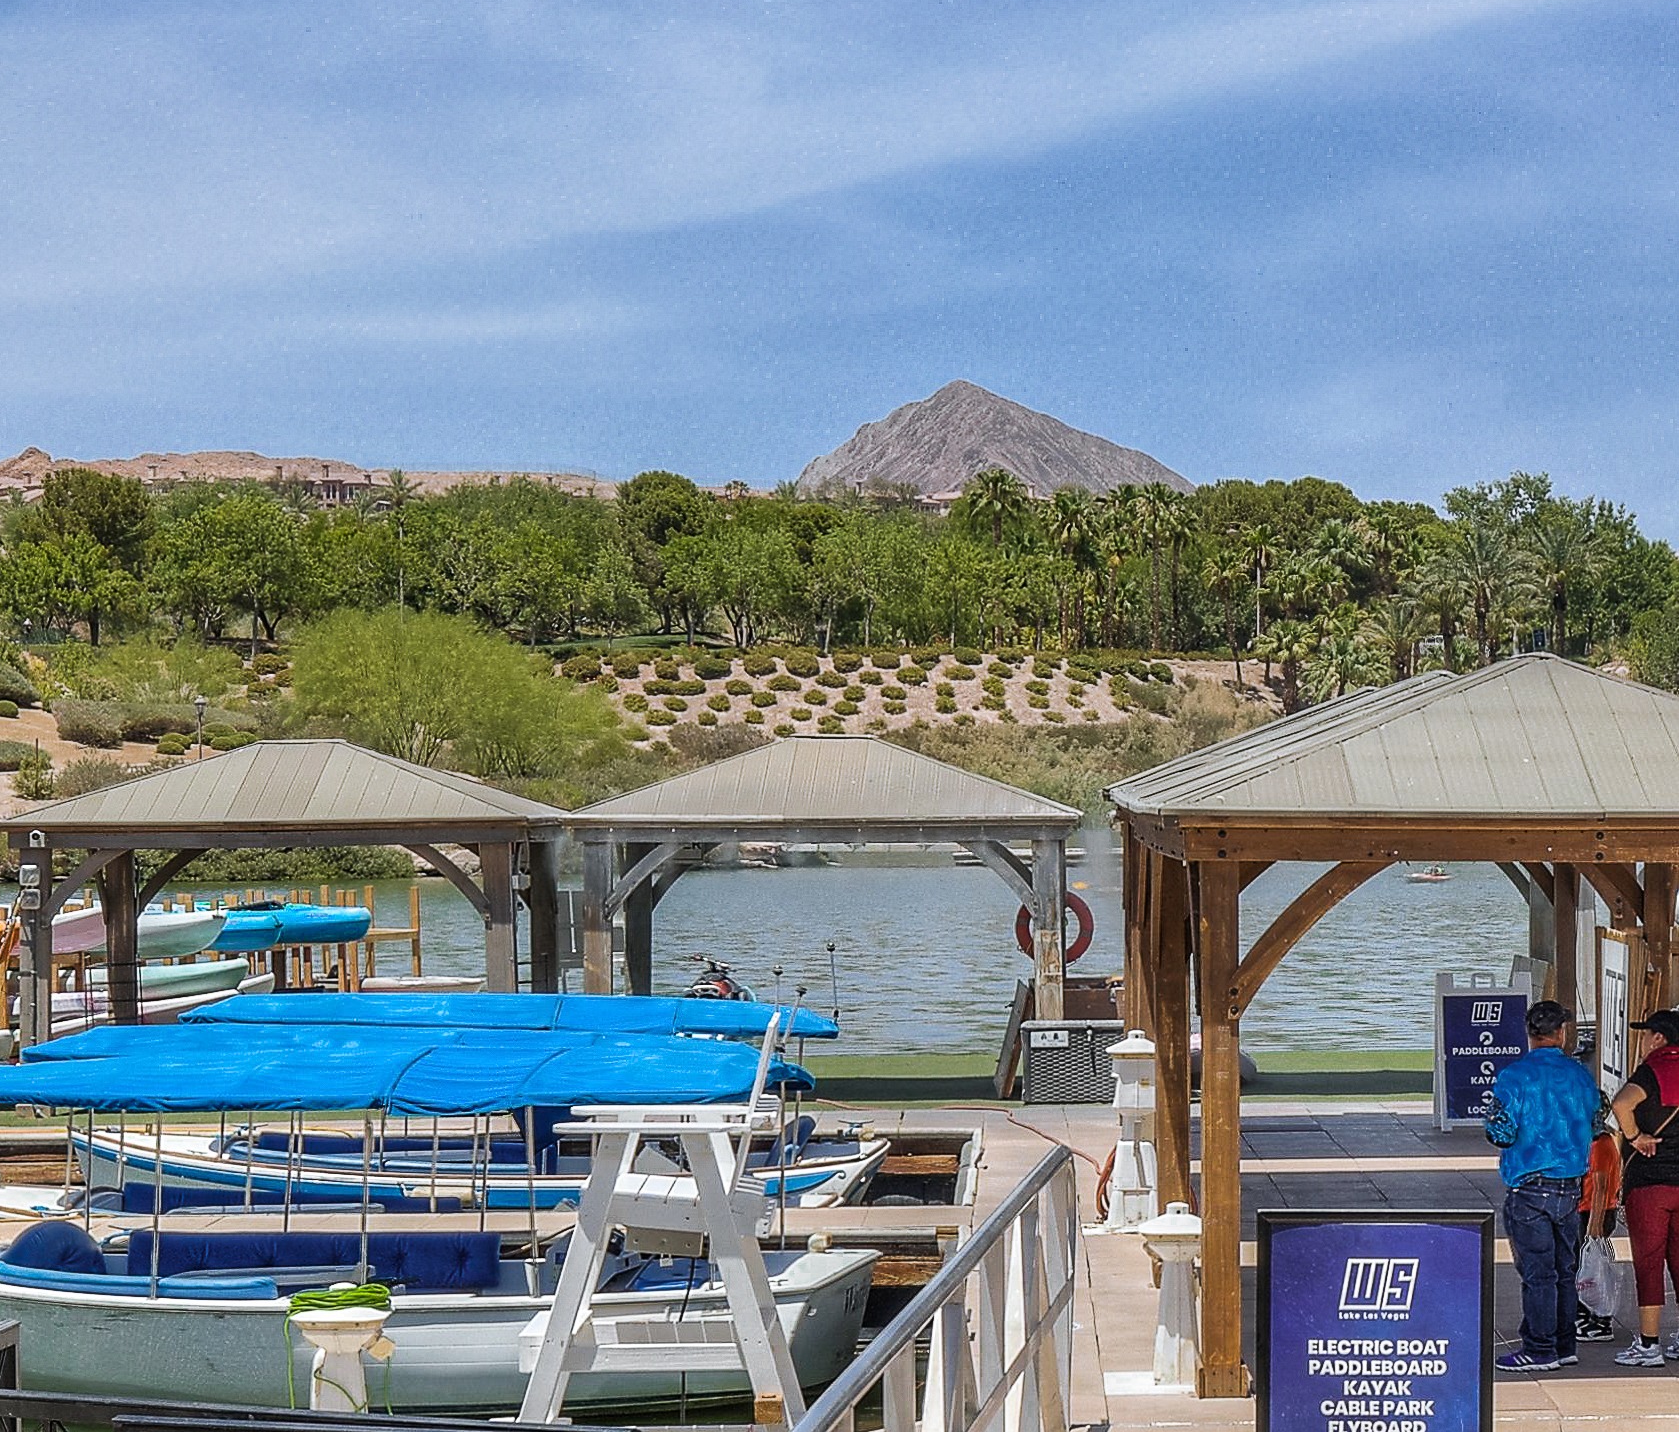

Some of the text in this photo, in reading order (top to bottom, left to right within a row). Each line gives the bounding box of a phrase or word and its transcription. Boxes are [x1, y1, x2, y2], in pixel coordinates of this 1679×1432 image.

[1471, 1002, 1503, 1023] WS
[1452, 1047, 1521, 1056] PADDLEBOARD
[1470, 1076, 1498, 1085] KAYA
[1338, 1258, 1419, 1310] WS
[1338, 1312, 1359, 1320] Lake
[1381, 1312, 1410, 1321] Vegas
[1307, 1340, 1449, 1355] ELECTRIC BOAT
[1308, 1360, 1447, 1375] PADDLEBOARD
[1343, 1380, 1412, 1395] KAYAK
[1320, 1400, 1435, 1416] CABLE PARK
